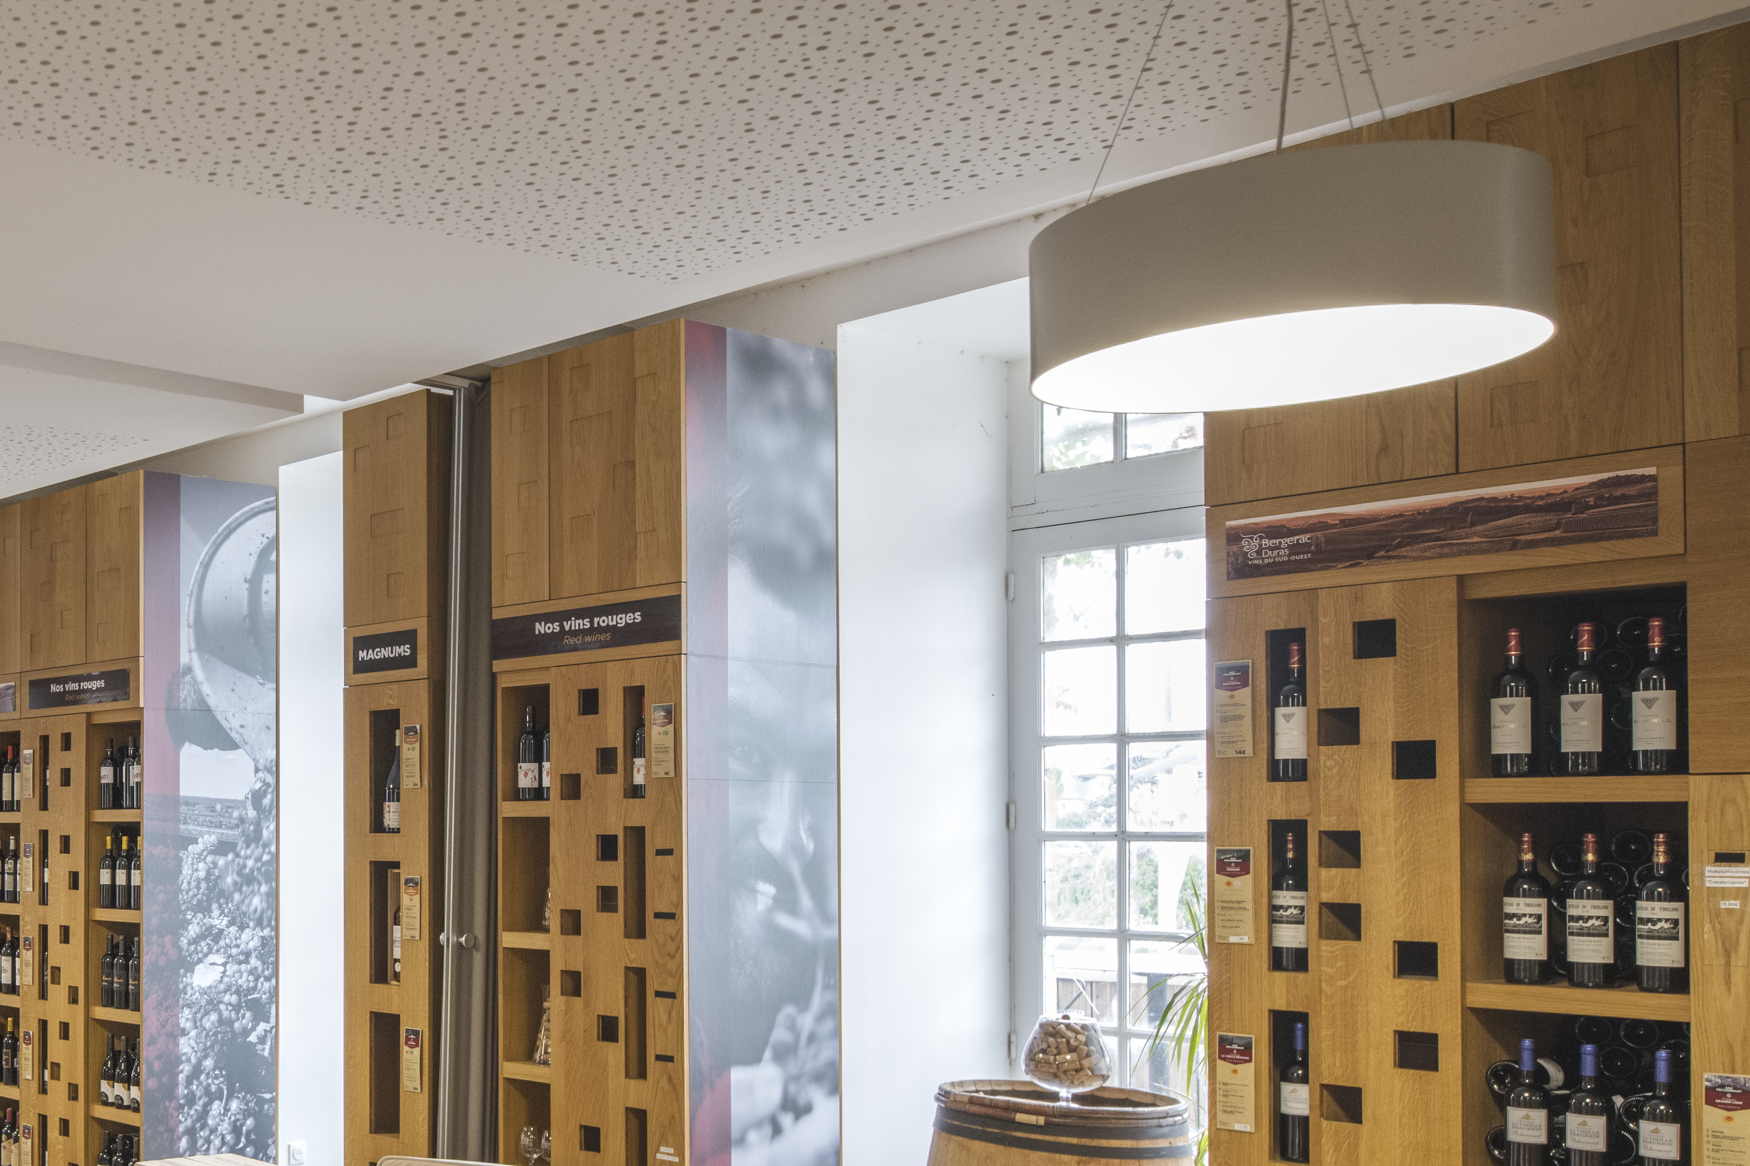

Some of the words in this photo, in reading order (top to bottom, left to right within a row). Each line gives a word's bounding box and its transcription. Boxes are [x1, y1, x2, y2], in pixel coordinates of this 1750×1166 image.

[1262, 535, 1312, 548] Bergerac
[1262, 548, 1289, 558] Duras
[534, 620, 560, 635] Nos
[563, 616, 591, 632] vins
[593, 611, 642, 631] rouges
[563, 634, 582, 645] Red
[584, 632, 611, 643] wines
[358, 644, 411, 661] MAGNUMS
[50, 683, 64, 693] Nos
[65, 681, 79, 692] vins
[80, 679, 105, 691] rouges
[65, 693, 75, 702] Red
